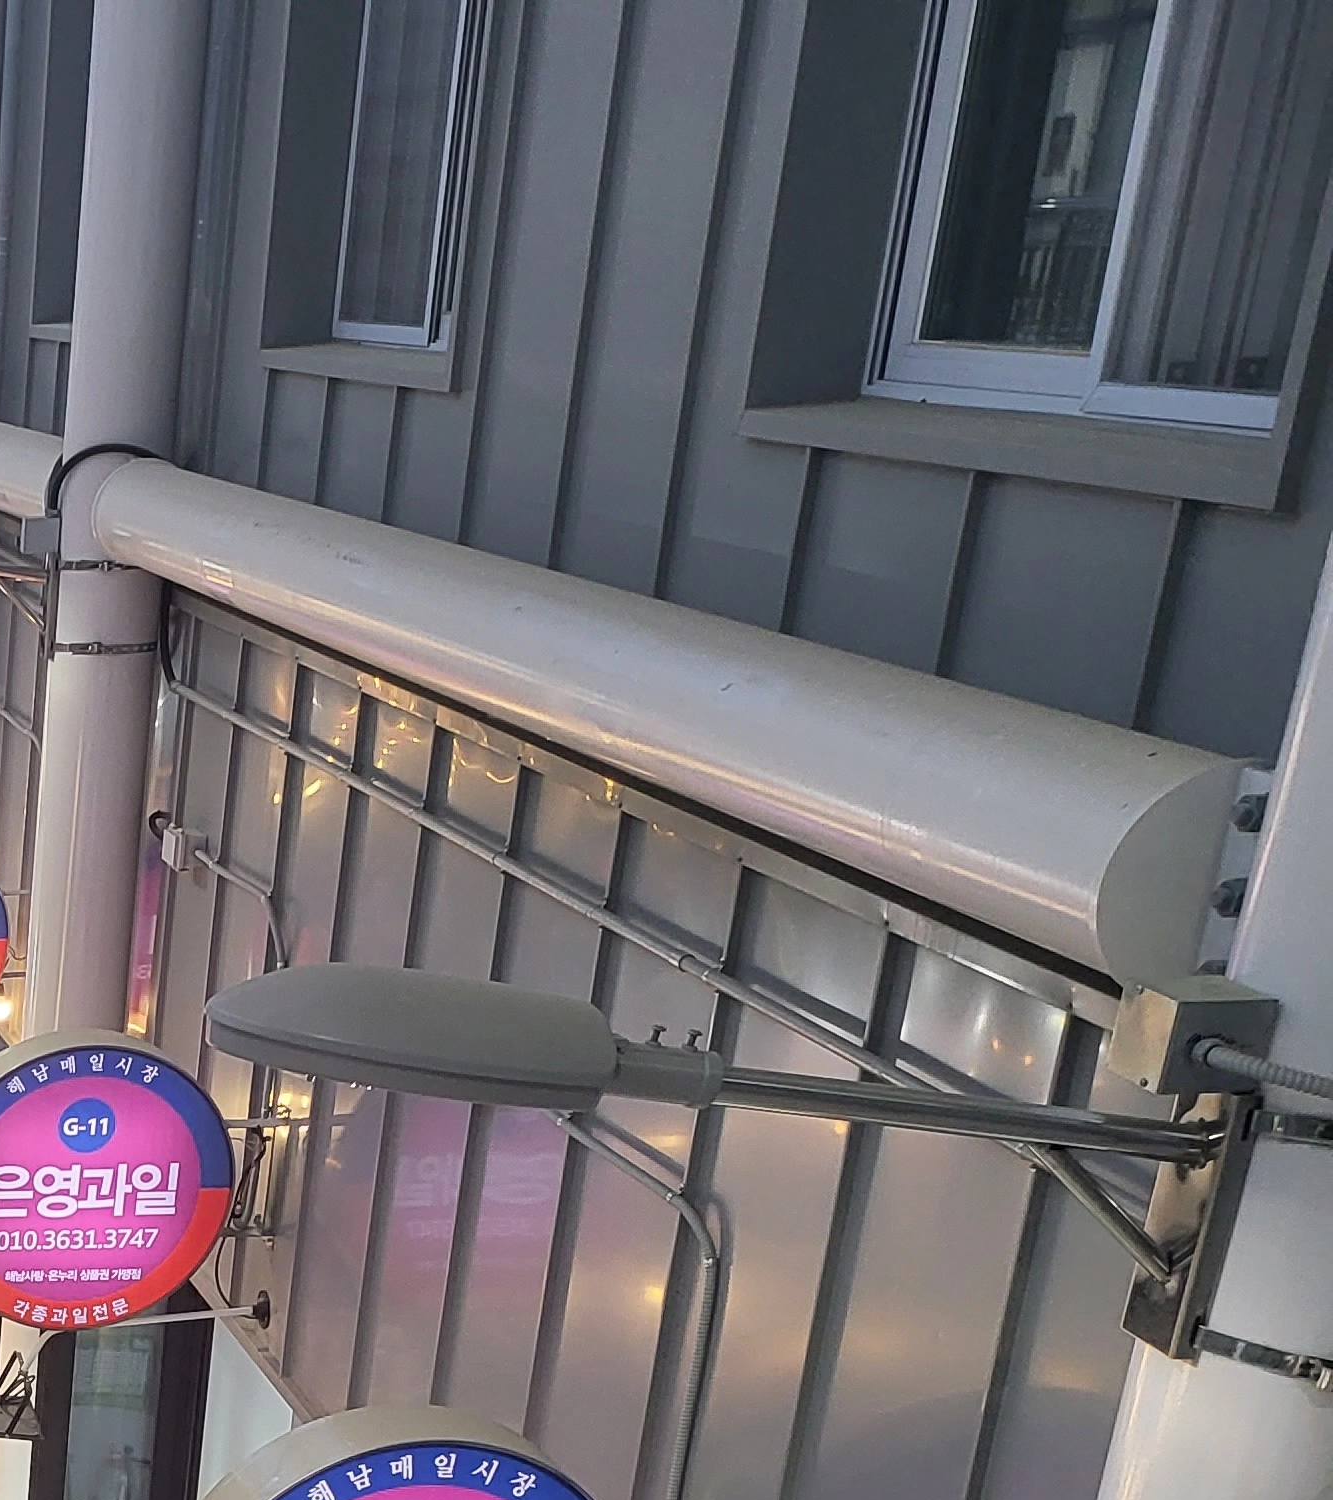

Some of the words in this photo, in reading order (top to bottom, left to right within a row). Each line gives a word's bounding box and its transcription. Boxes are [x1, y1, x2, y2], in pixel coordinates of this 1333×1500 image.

[6, 1054, 160, 1094] 해남매일시장
[62, 1117, 110, 1136] G-11
[13, 1299, 130, 1325] 각종과일전문
